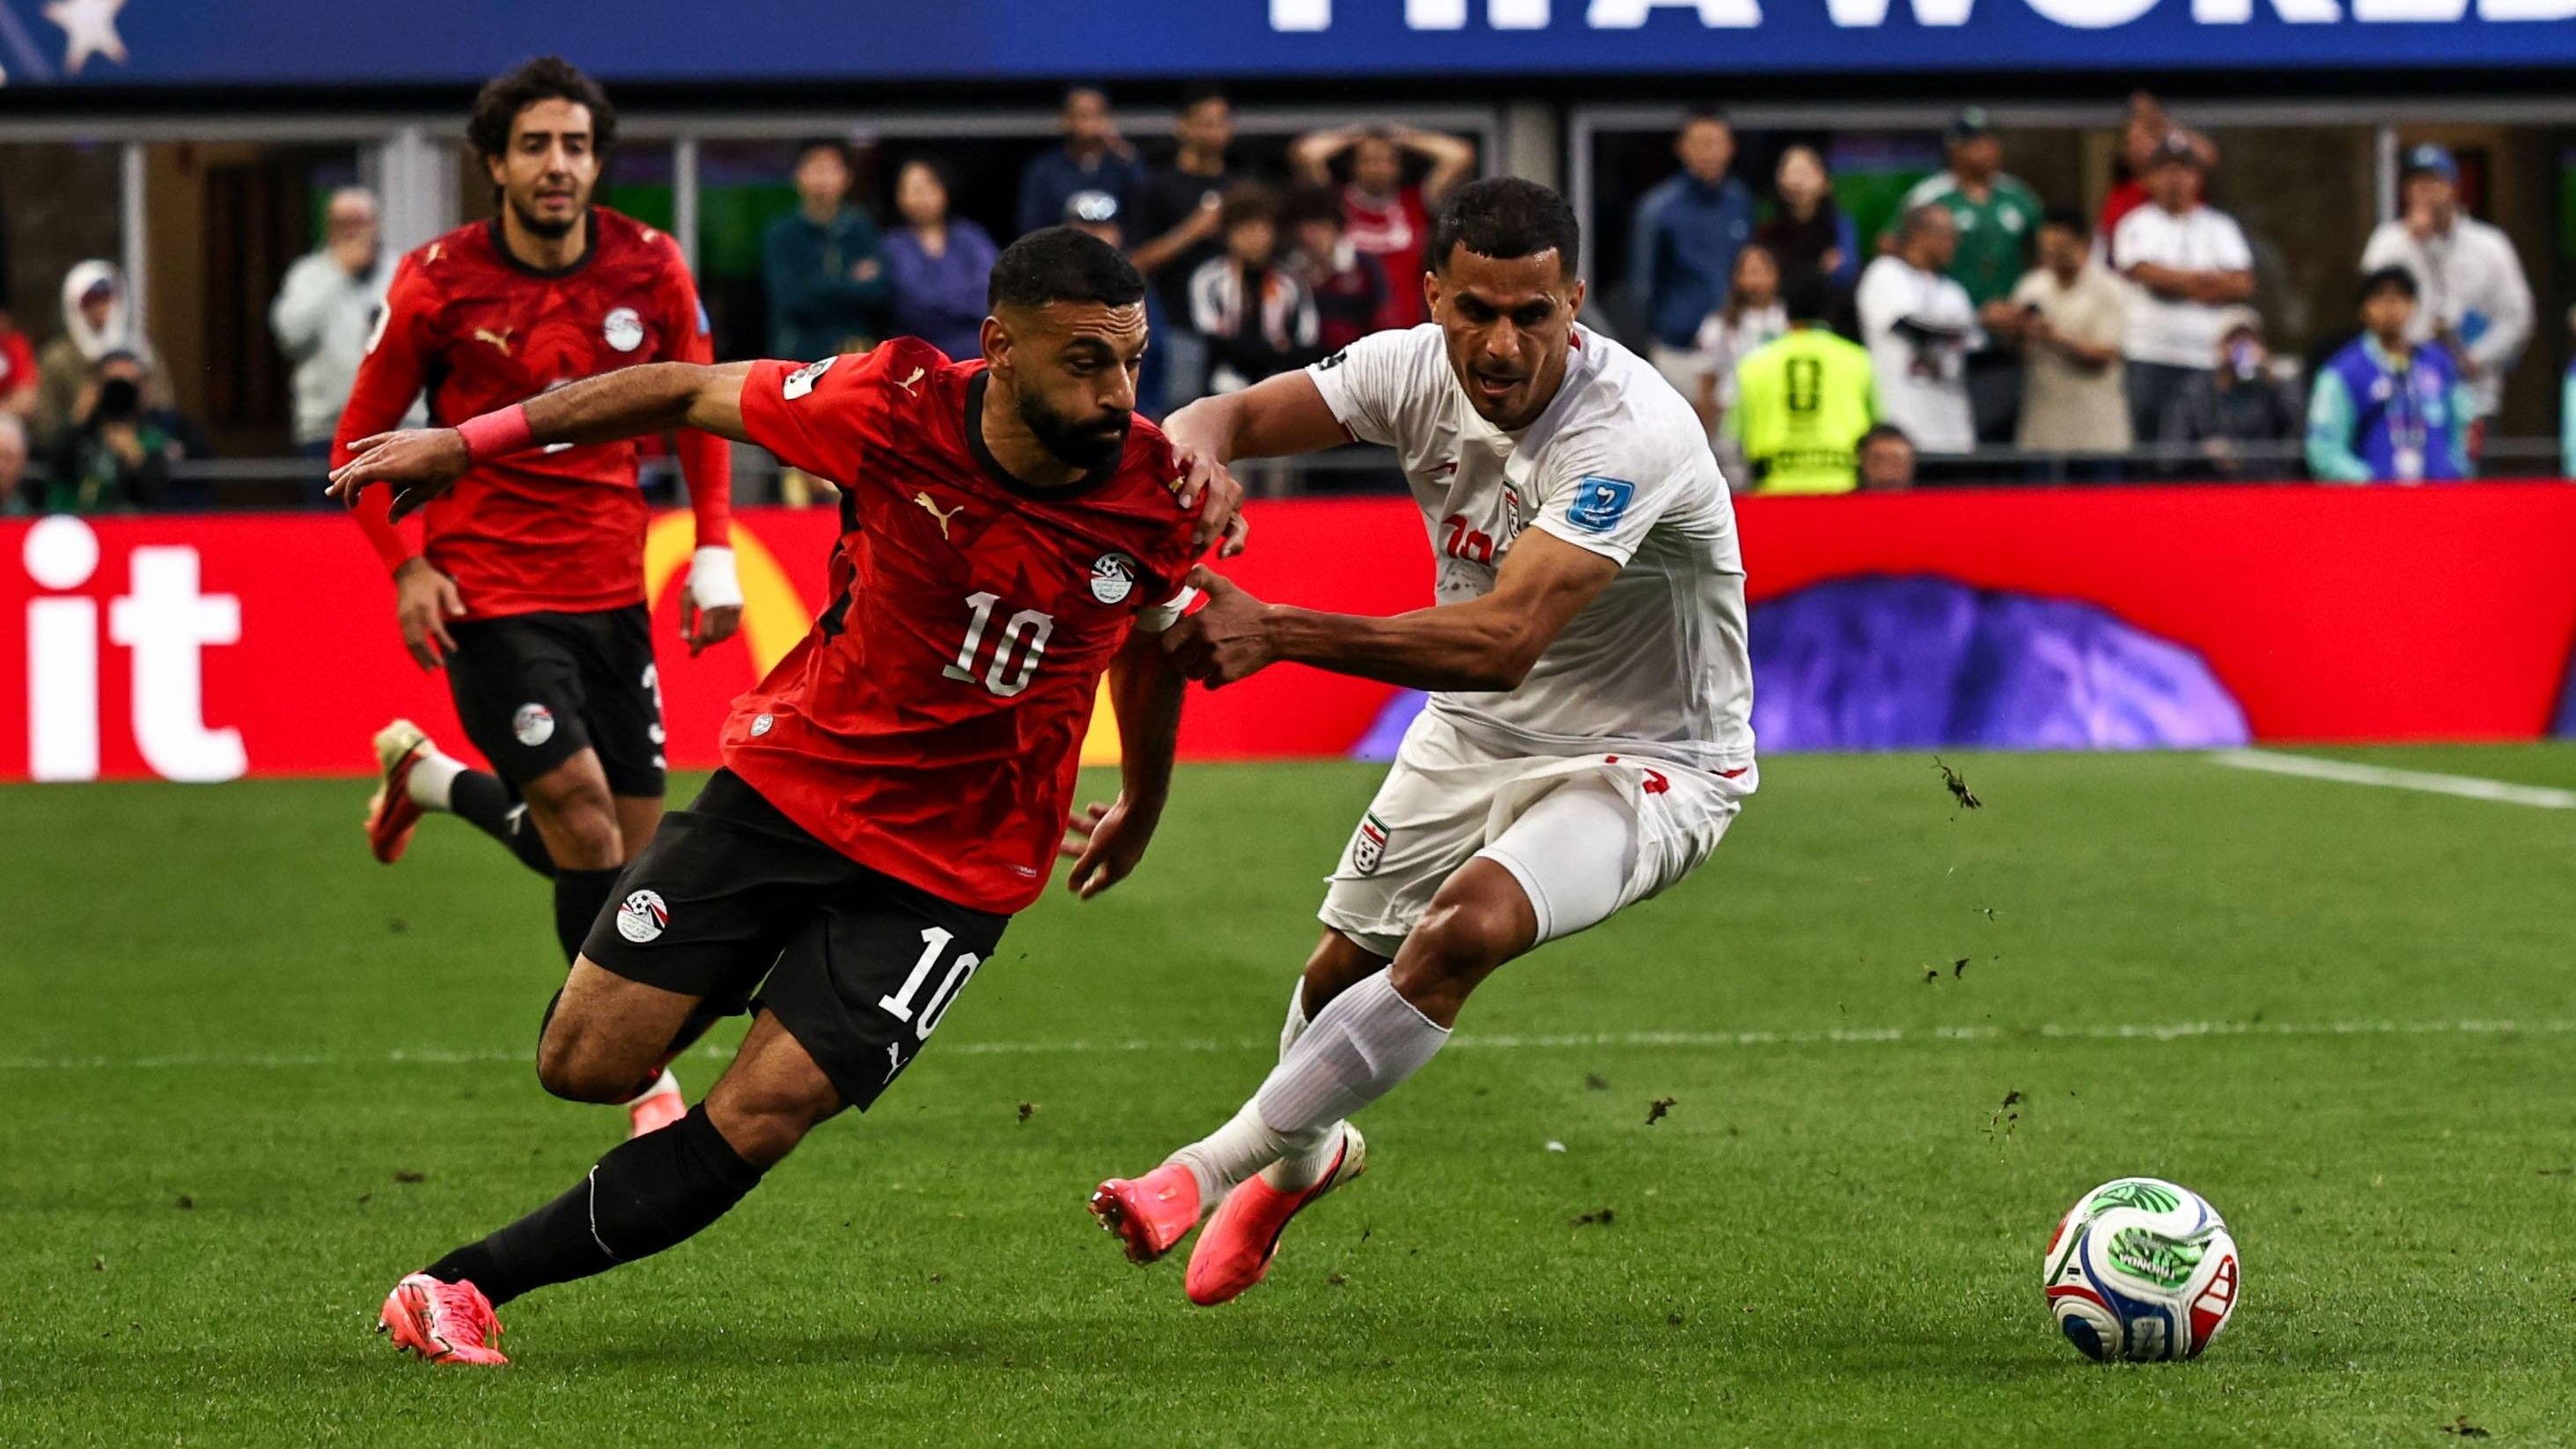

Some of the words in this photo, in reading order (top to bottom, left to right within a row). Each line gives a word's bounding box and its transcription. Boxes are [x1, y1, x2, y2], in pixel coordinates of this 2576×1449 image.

[24, 514, 247, 783] it
[942, 592, 1054, 696] 10
[879, 927, 979, 1041] 10
